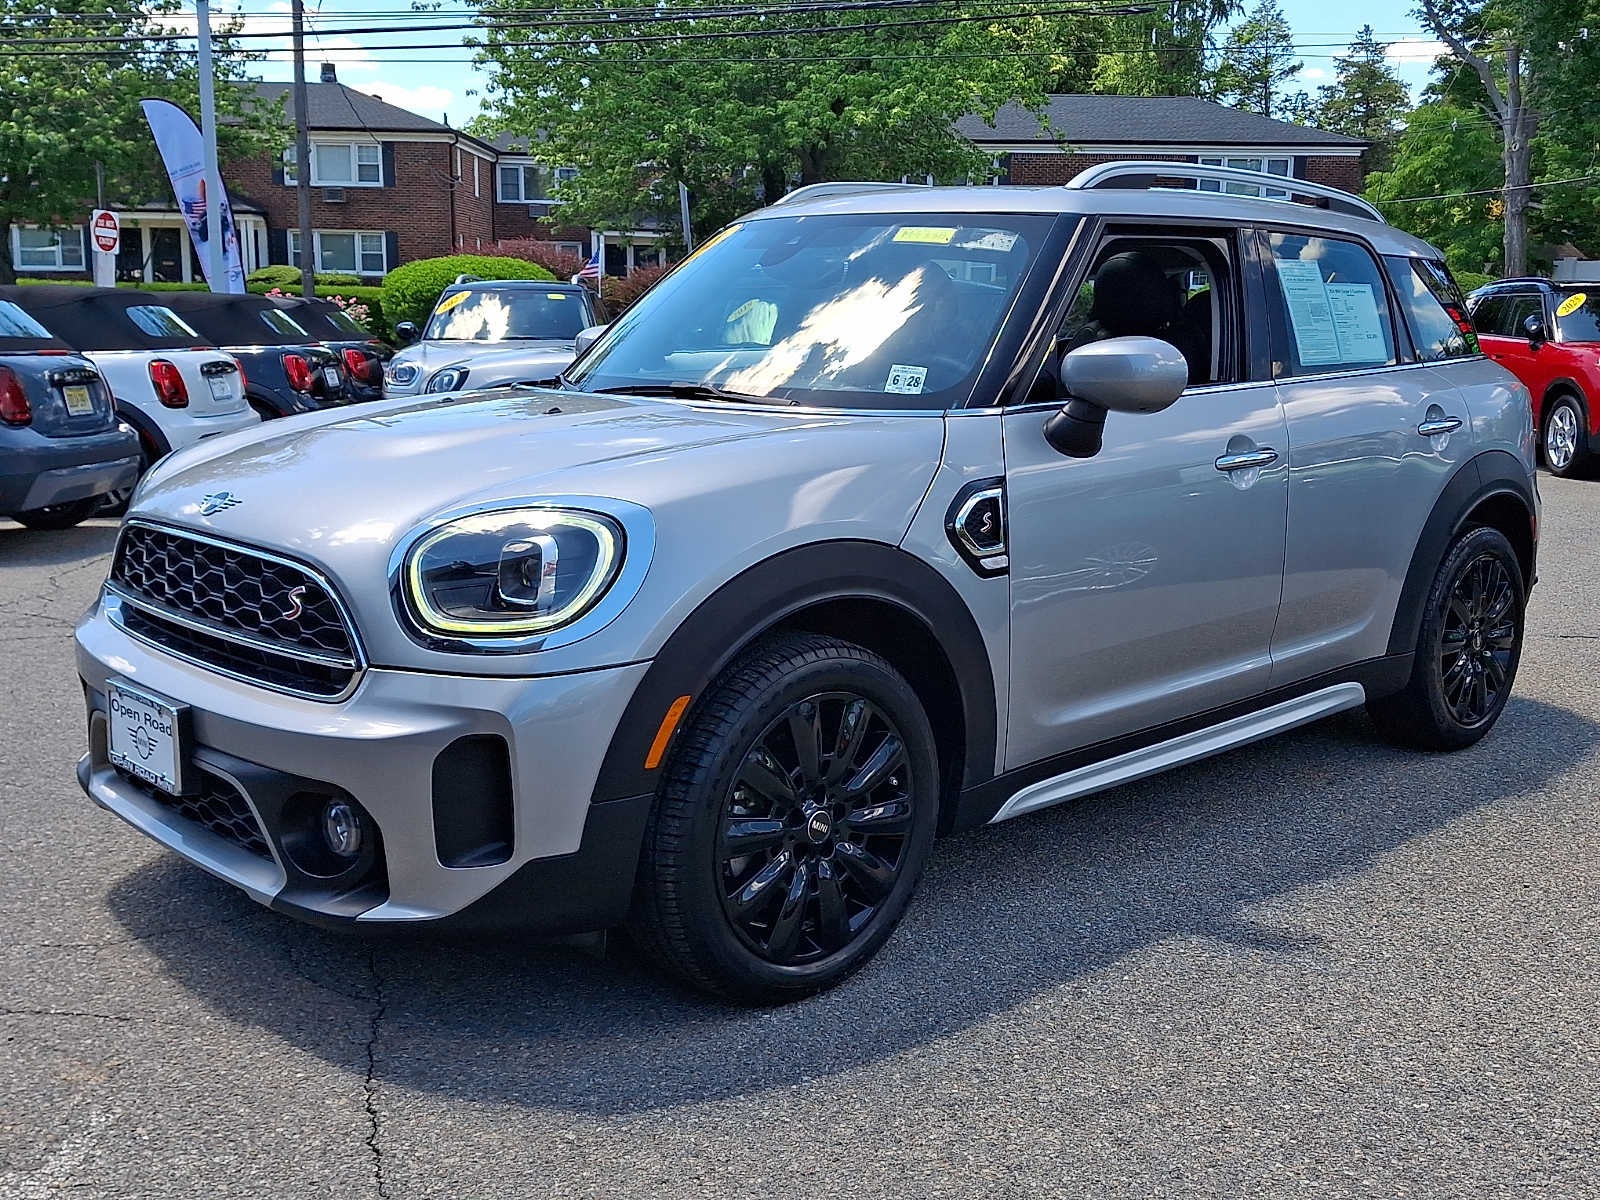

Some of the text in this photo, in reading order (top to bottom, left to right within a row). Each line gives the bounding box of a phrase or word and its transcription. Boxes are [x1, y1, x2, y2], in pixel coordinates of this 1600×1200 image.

[892, 374, 921, 388] 6 28
[980, 511, 993, 533] S
[282, 585, 306, 621] S
[111, 698, 140, 721] Open
[144, 712, 172, 737] Road
[134, 765, 156, 782] ROAD
[811, 819, 829, 833] MINI
